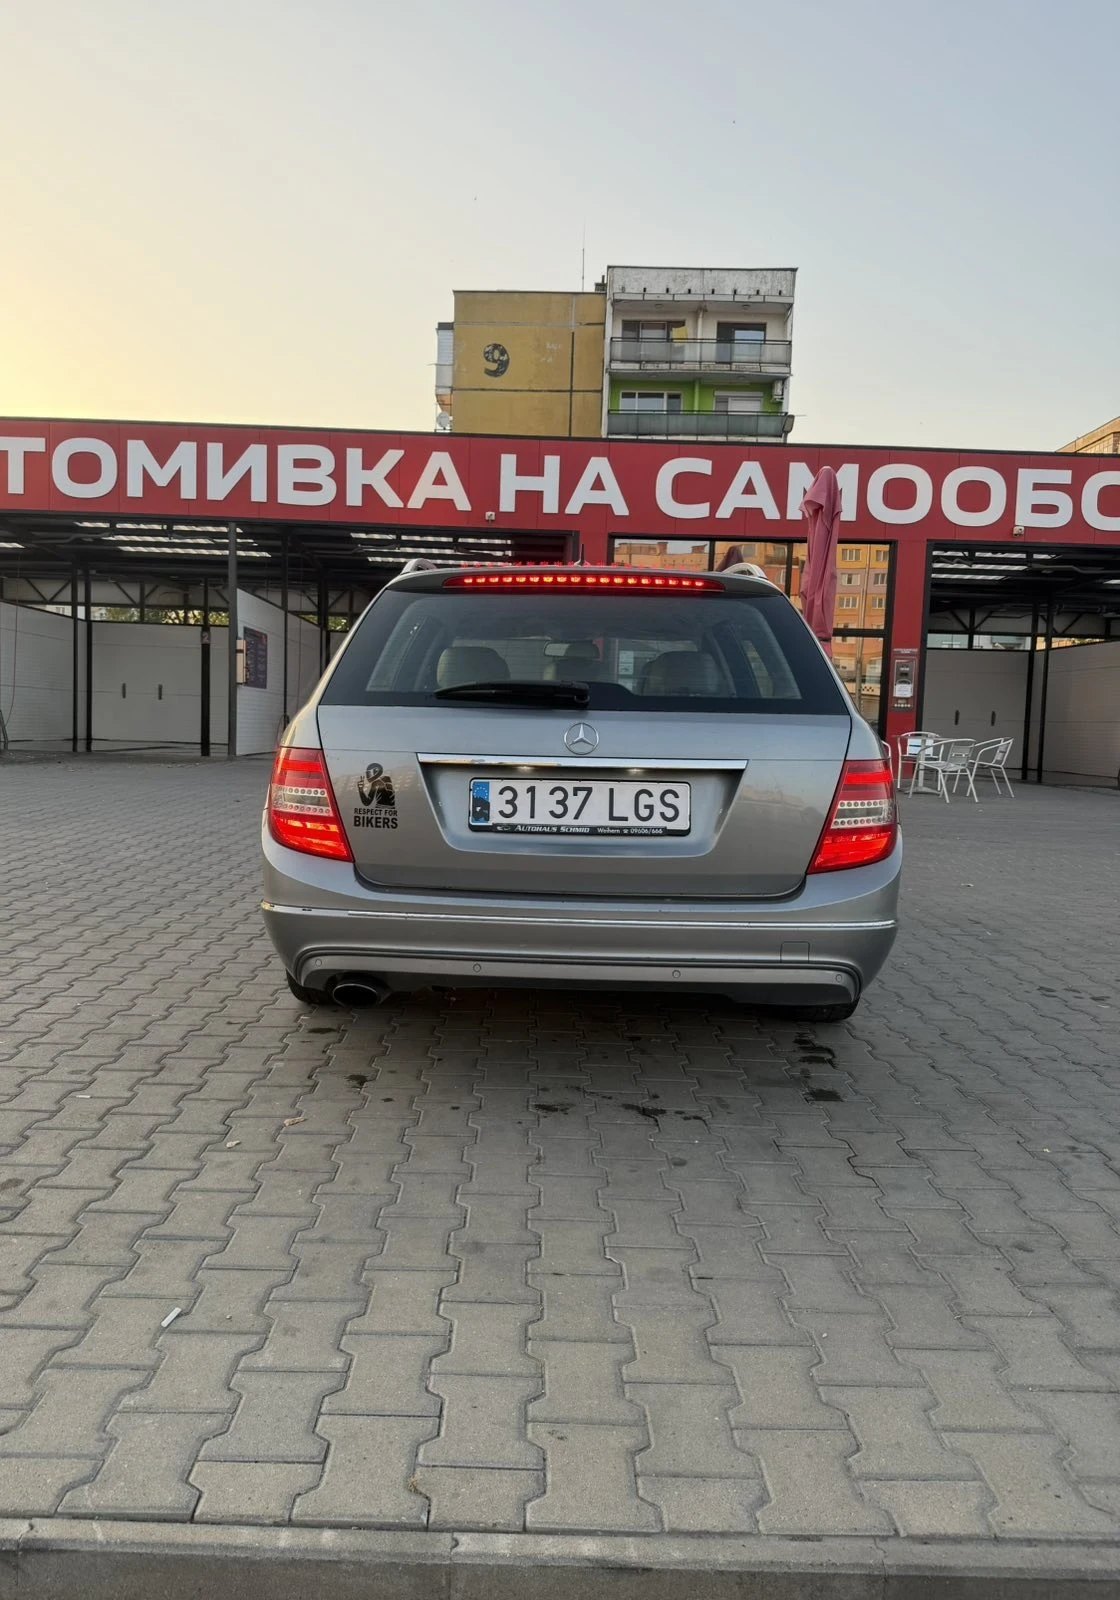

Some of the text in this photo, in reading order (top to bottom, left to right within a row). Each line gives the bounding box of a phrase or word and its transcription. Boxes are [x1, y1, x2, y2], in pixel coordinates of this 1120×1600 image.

[483, 343, 510, 378] 9
[0, 436, 472, 512] ТОМИВКА
[500, 454, 630, 516] НА
[354, 808, 398, 817] RESPECT FOR
[498, 785, 680, 823] 3137 LGS
[353, 816, 398, 829] BIKERS
[514, 824, 558, 832] AUTOHAUS
